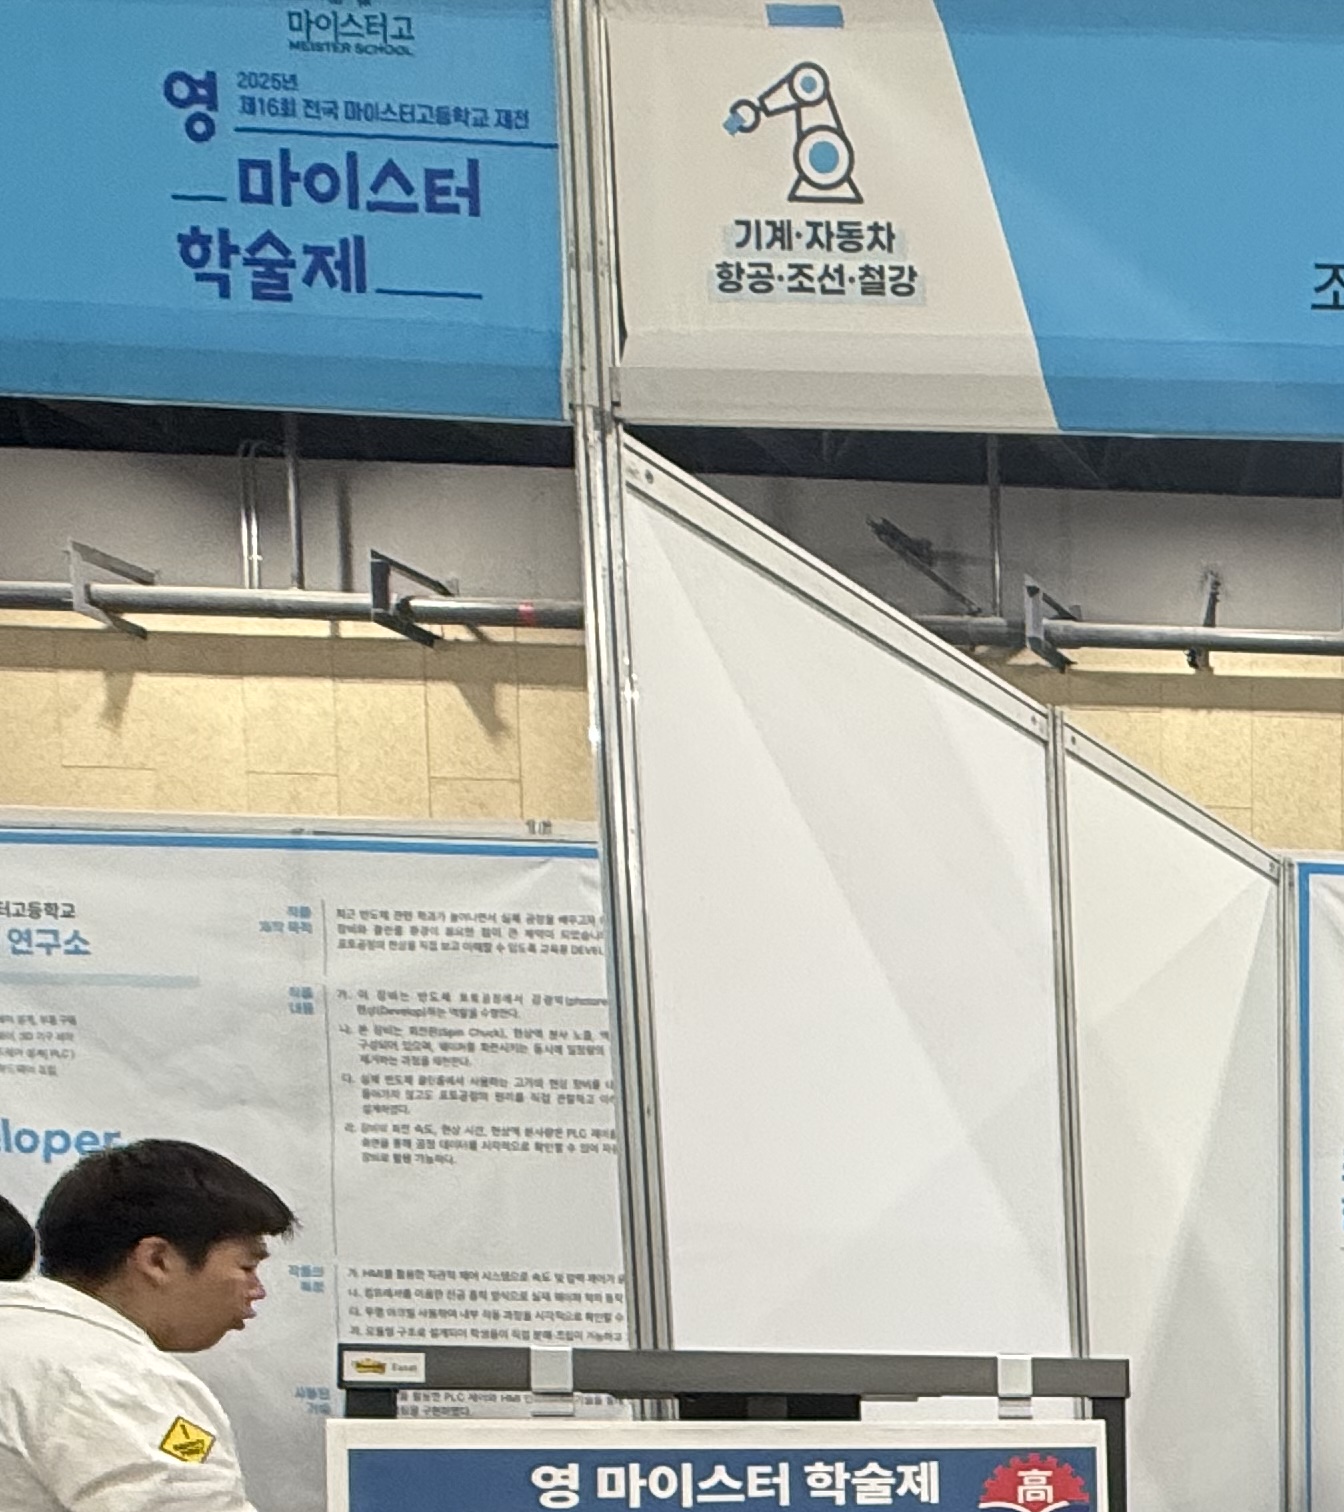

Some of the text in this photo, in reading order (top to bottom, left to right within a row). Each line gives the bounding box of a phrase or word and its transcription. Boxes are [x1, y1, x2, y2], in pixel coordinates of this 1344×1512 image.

[288, 10, 414, 43] 마이스터고
[289, 41, 413, 56] MEISTER SCHOOL
[237, 72, 298, 91] 2025년
[164, 71, 218, 143] 영
[240, 95, 296, 118] 제16회
[304, 98, 339, 120] 전국
[345, 100, 489, 128] 마이스터고등학교
[238, 148, 480, 217] 마이스터
[734, 219, 895, 253] 기계·자동차
[177, 226, 367, 302] 학술제
[715, 261, 917, 297] 항공·조선·철강
[7, 928, 91, 956] 연구소
[531, 1460, 940, 1511] 영 마이스터 학술제
[1015, 1469, 1055, 1504] 高
